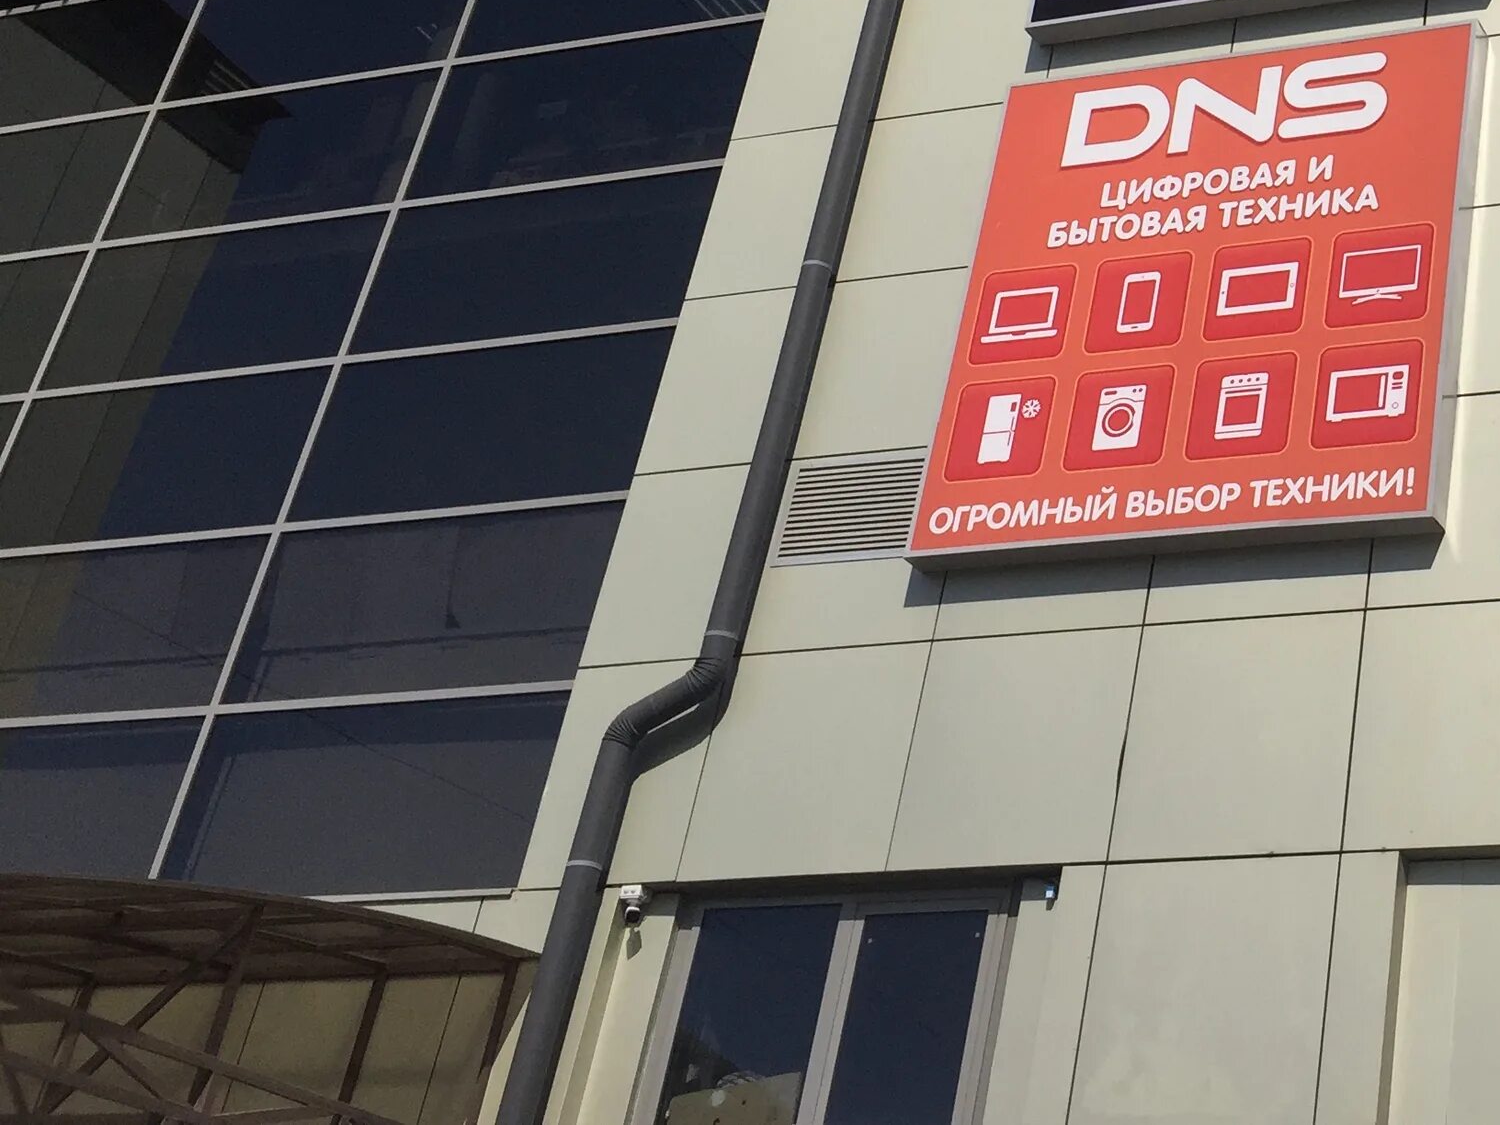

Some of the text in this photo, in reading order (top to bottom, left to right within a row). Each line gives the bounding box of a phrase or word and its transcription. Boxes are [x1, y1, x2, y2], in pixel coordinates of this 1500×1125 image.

[1060, 51, 1388, 169] DNS
[1046, 183, 1379, 249] БЫТОВАЯ ТЕХНИКА
[1101, 155, 1333, 210] ЦИФРОВАЯ И
[928, 467, 1416, 535] ОГРОМНЫЙ ВЫБОР ТЕХНИКИ!
